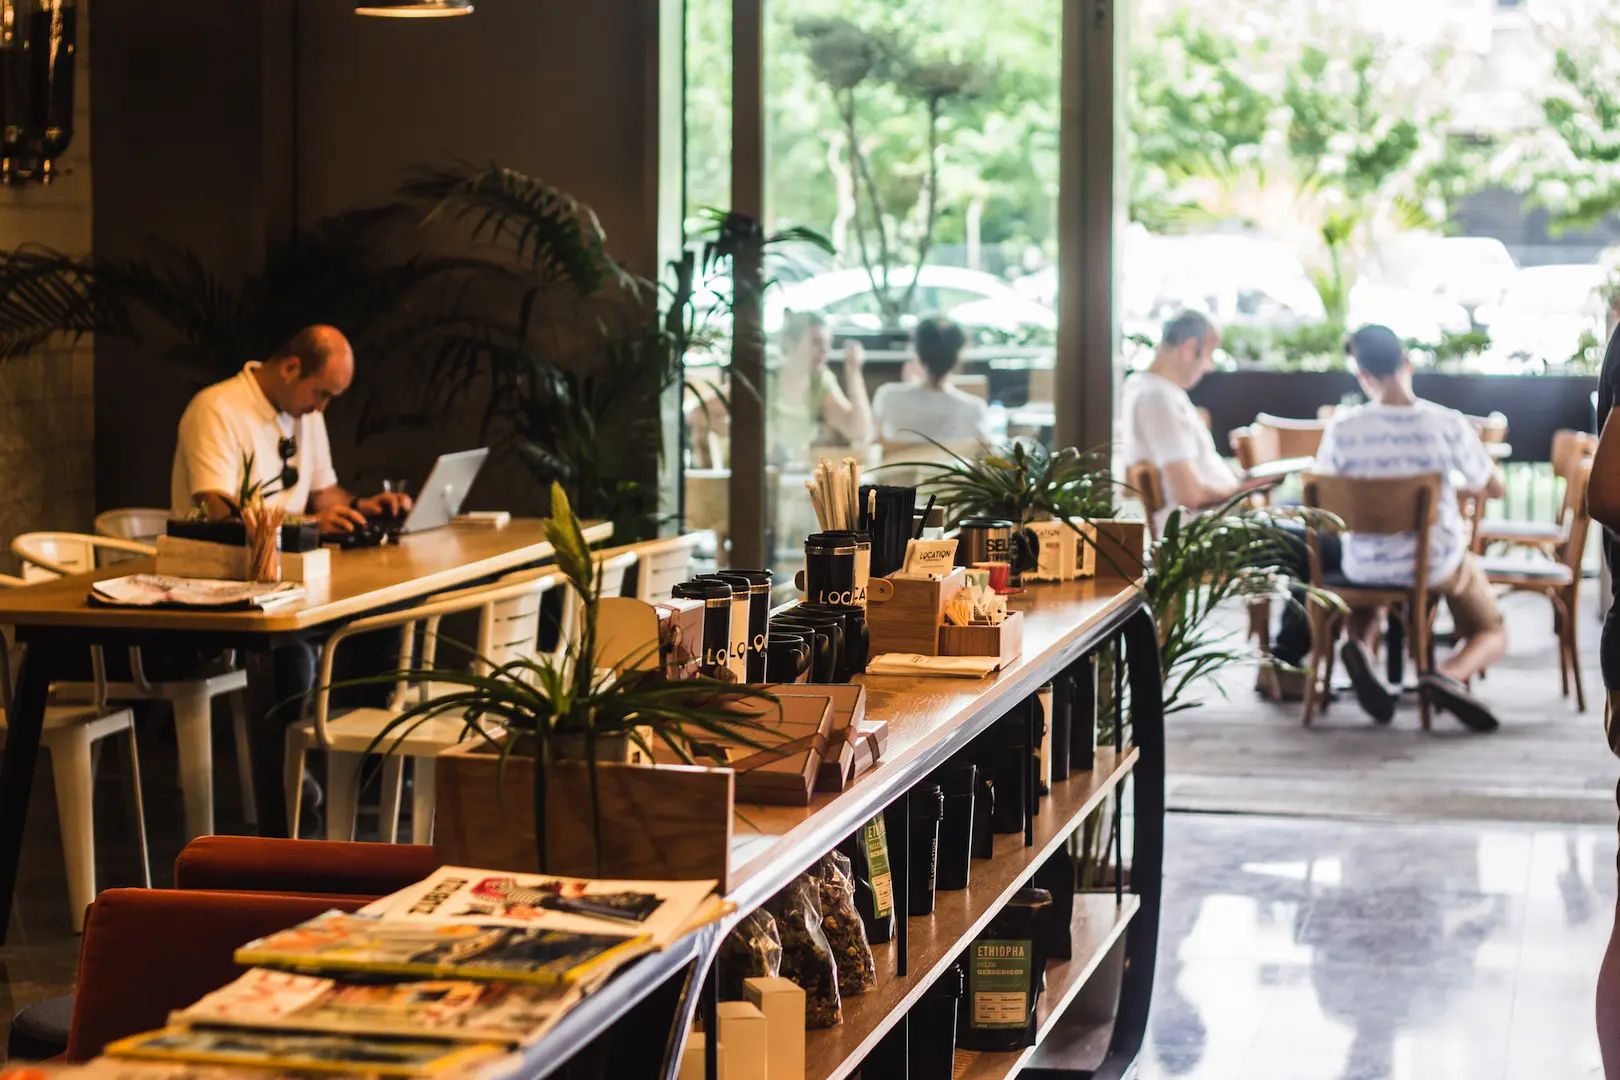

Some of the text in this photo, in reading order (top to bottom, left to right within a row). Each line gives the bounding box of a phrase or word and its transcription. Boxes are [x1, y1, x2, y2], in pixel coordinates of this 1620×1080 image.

[1036, 529, 1060, 537] CATION
[919, 550, 951, 560] LOCATION
[977, 945, 1025, 957] ETHIOPHA
